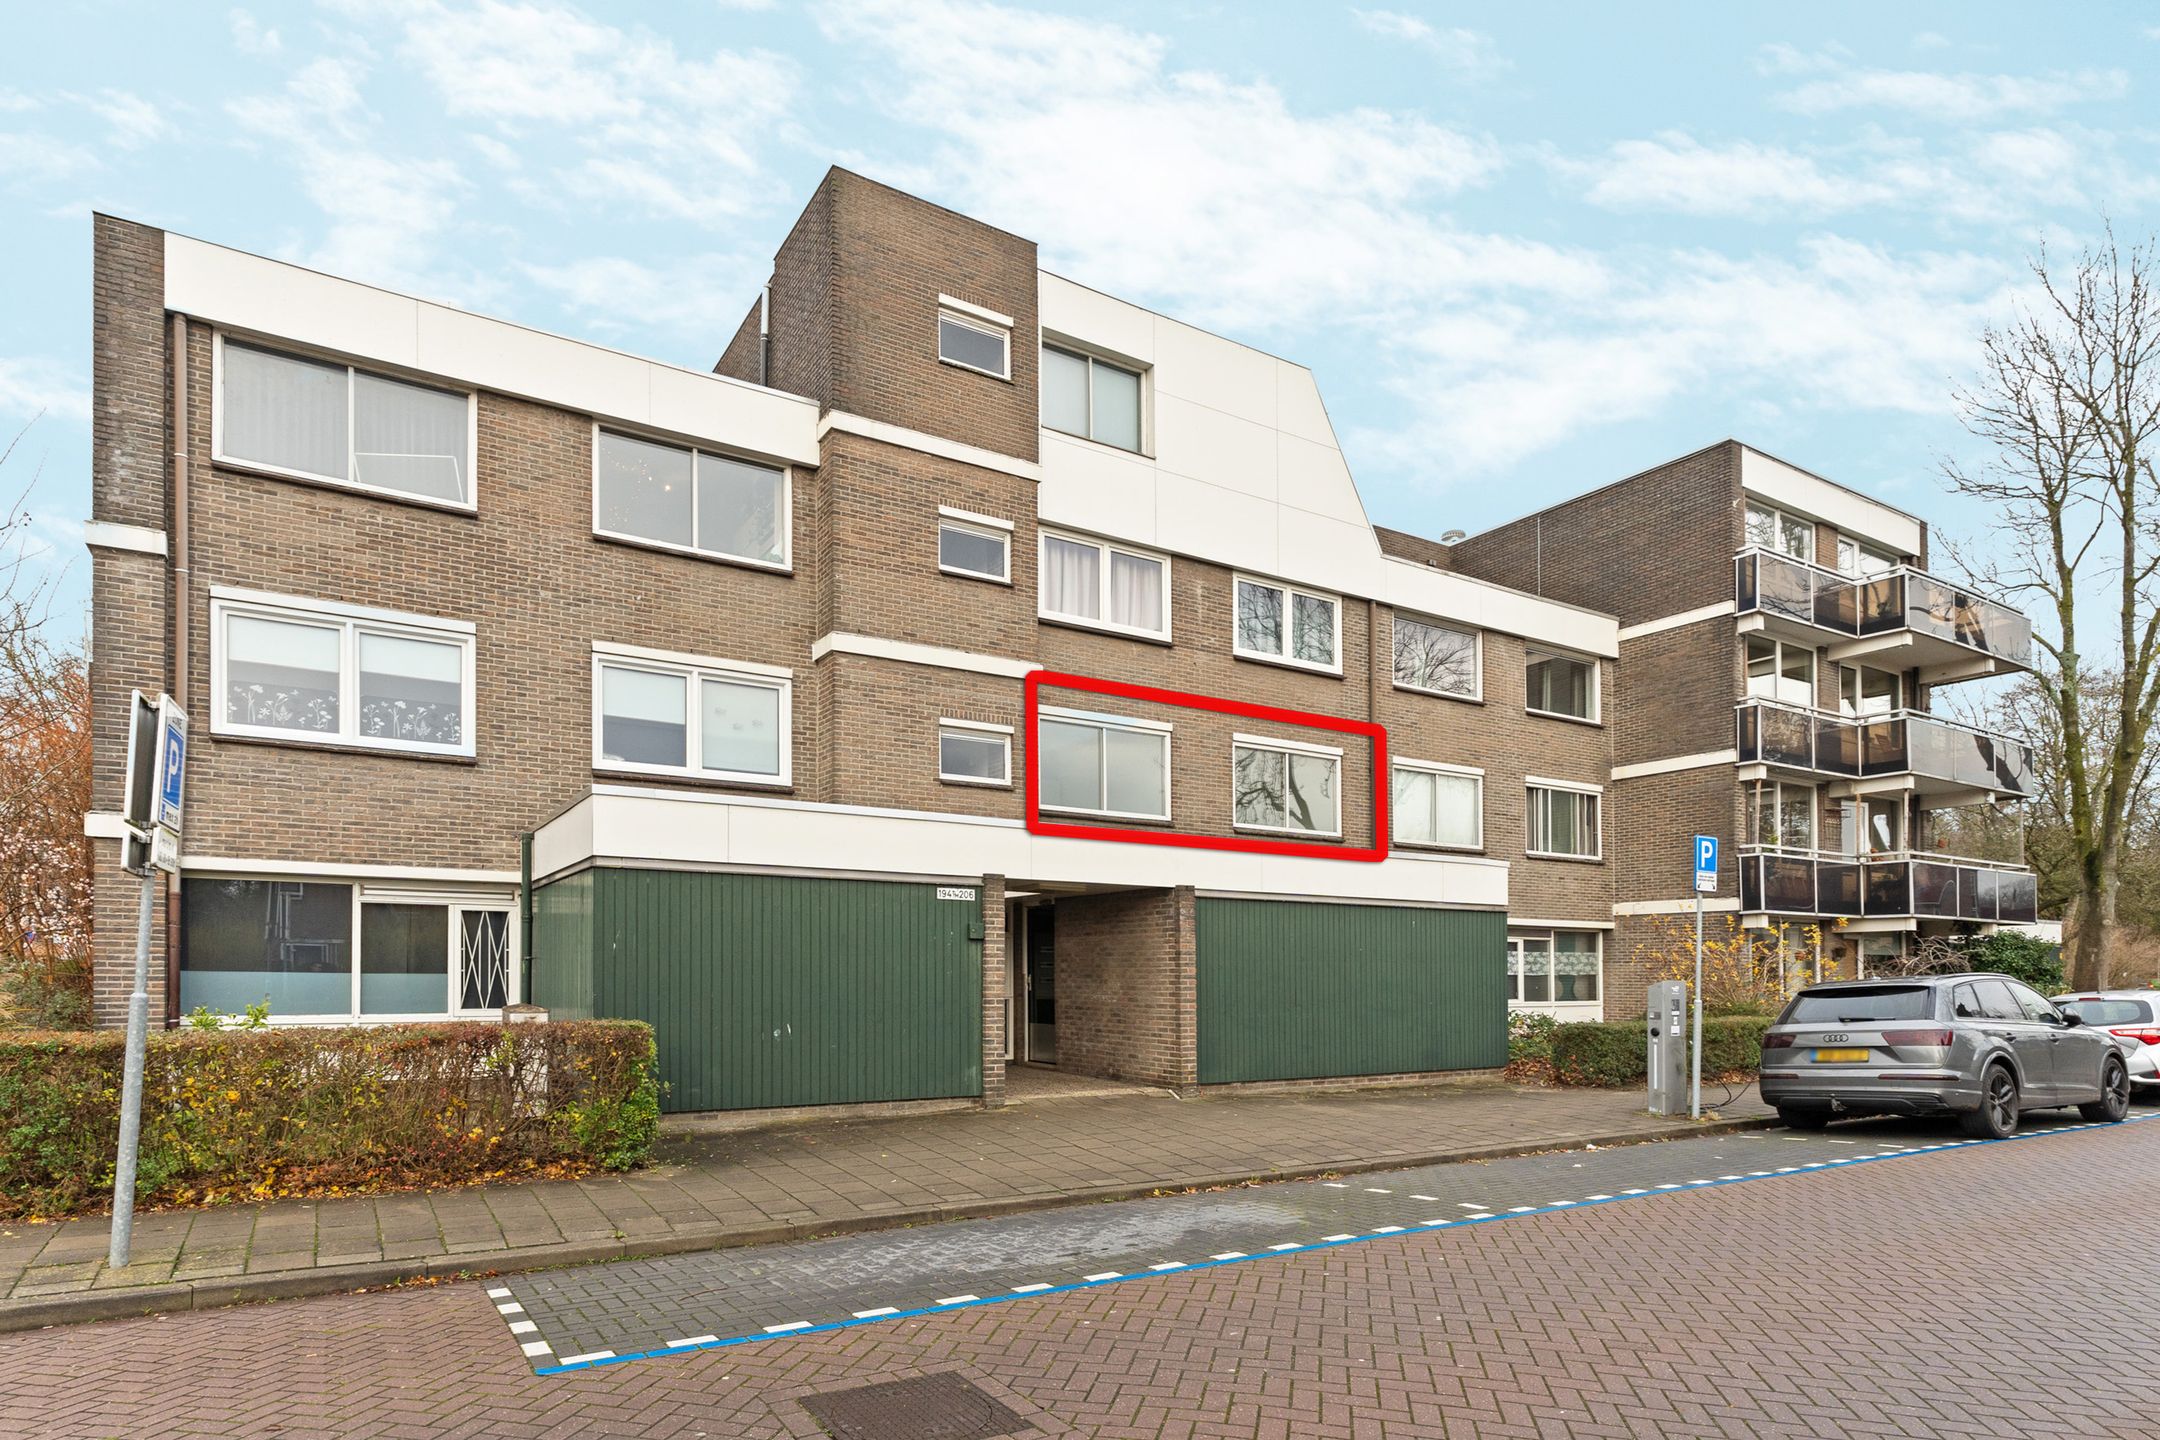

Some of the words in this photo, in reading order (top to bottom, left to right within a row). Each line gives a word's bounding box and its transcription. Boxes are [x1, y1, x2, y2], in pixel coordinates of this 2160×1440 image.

[167, 739, 179, 793] P
[1701, 840, 1713, 868] P
[938, 889, 951, 898] 194
[959, 890, 974, 899] 206
